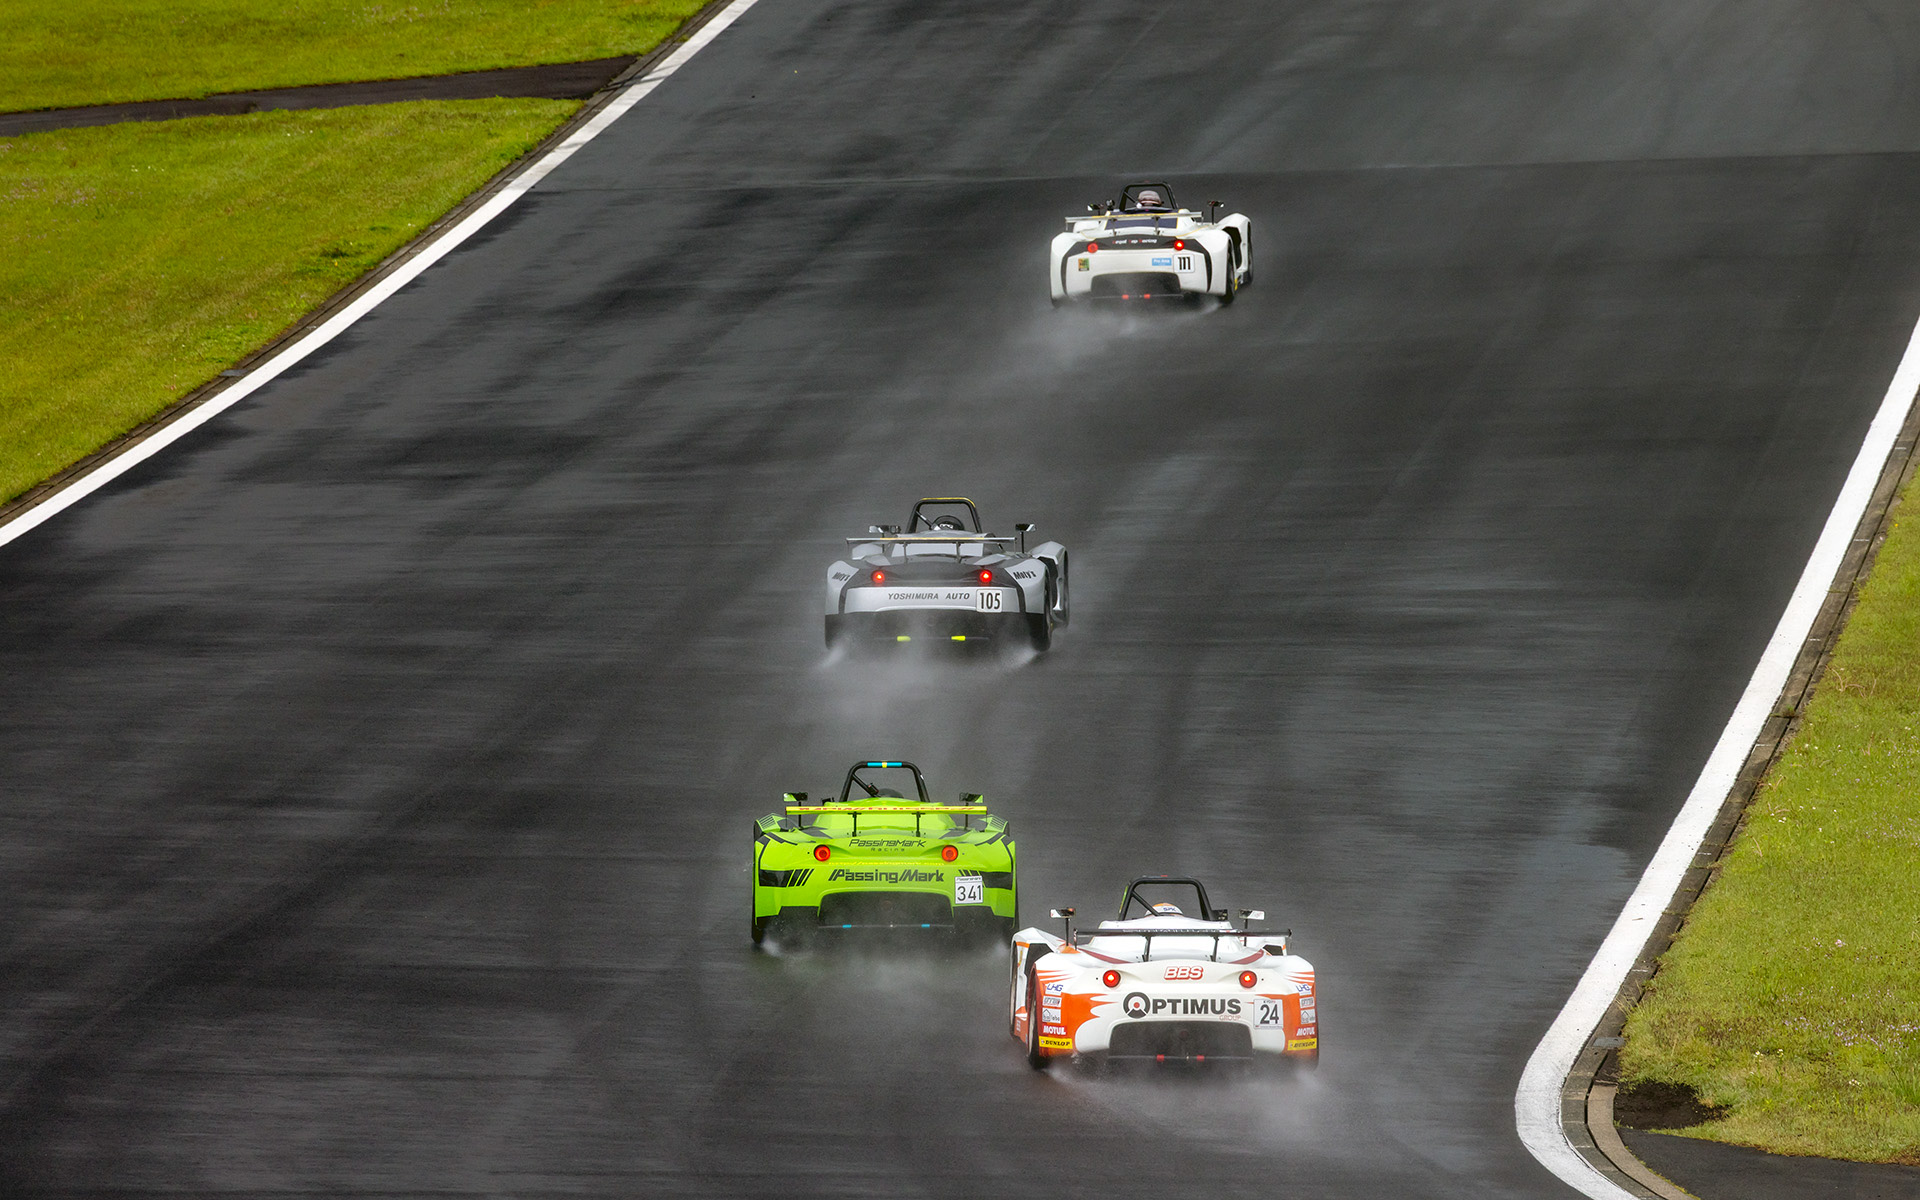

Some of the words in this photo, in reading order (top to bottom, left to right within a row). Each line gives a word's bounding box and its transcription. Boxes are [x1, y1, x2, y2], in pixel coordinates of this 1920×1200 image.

[1177, 256, 1191, 270] 111
[887, 592, 939, 601] YOSHIMURA
[945, 592, 971, 601] AUTO
[979, 592, 1001, 610] 105
[957, 884, 982, 902] 341
[1163, 965, 1204, 981] BBS
[1259, 1003, 1280, 1025] 24
[1042, 1025, 1067, 1036] MOTUL
[1044, 1039, 1071, 1047] DUNLOP
